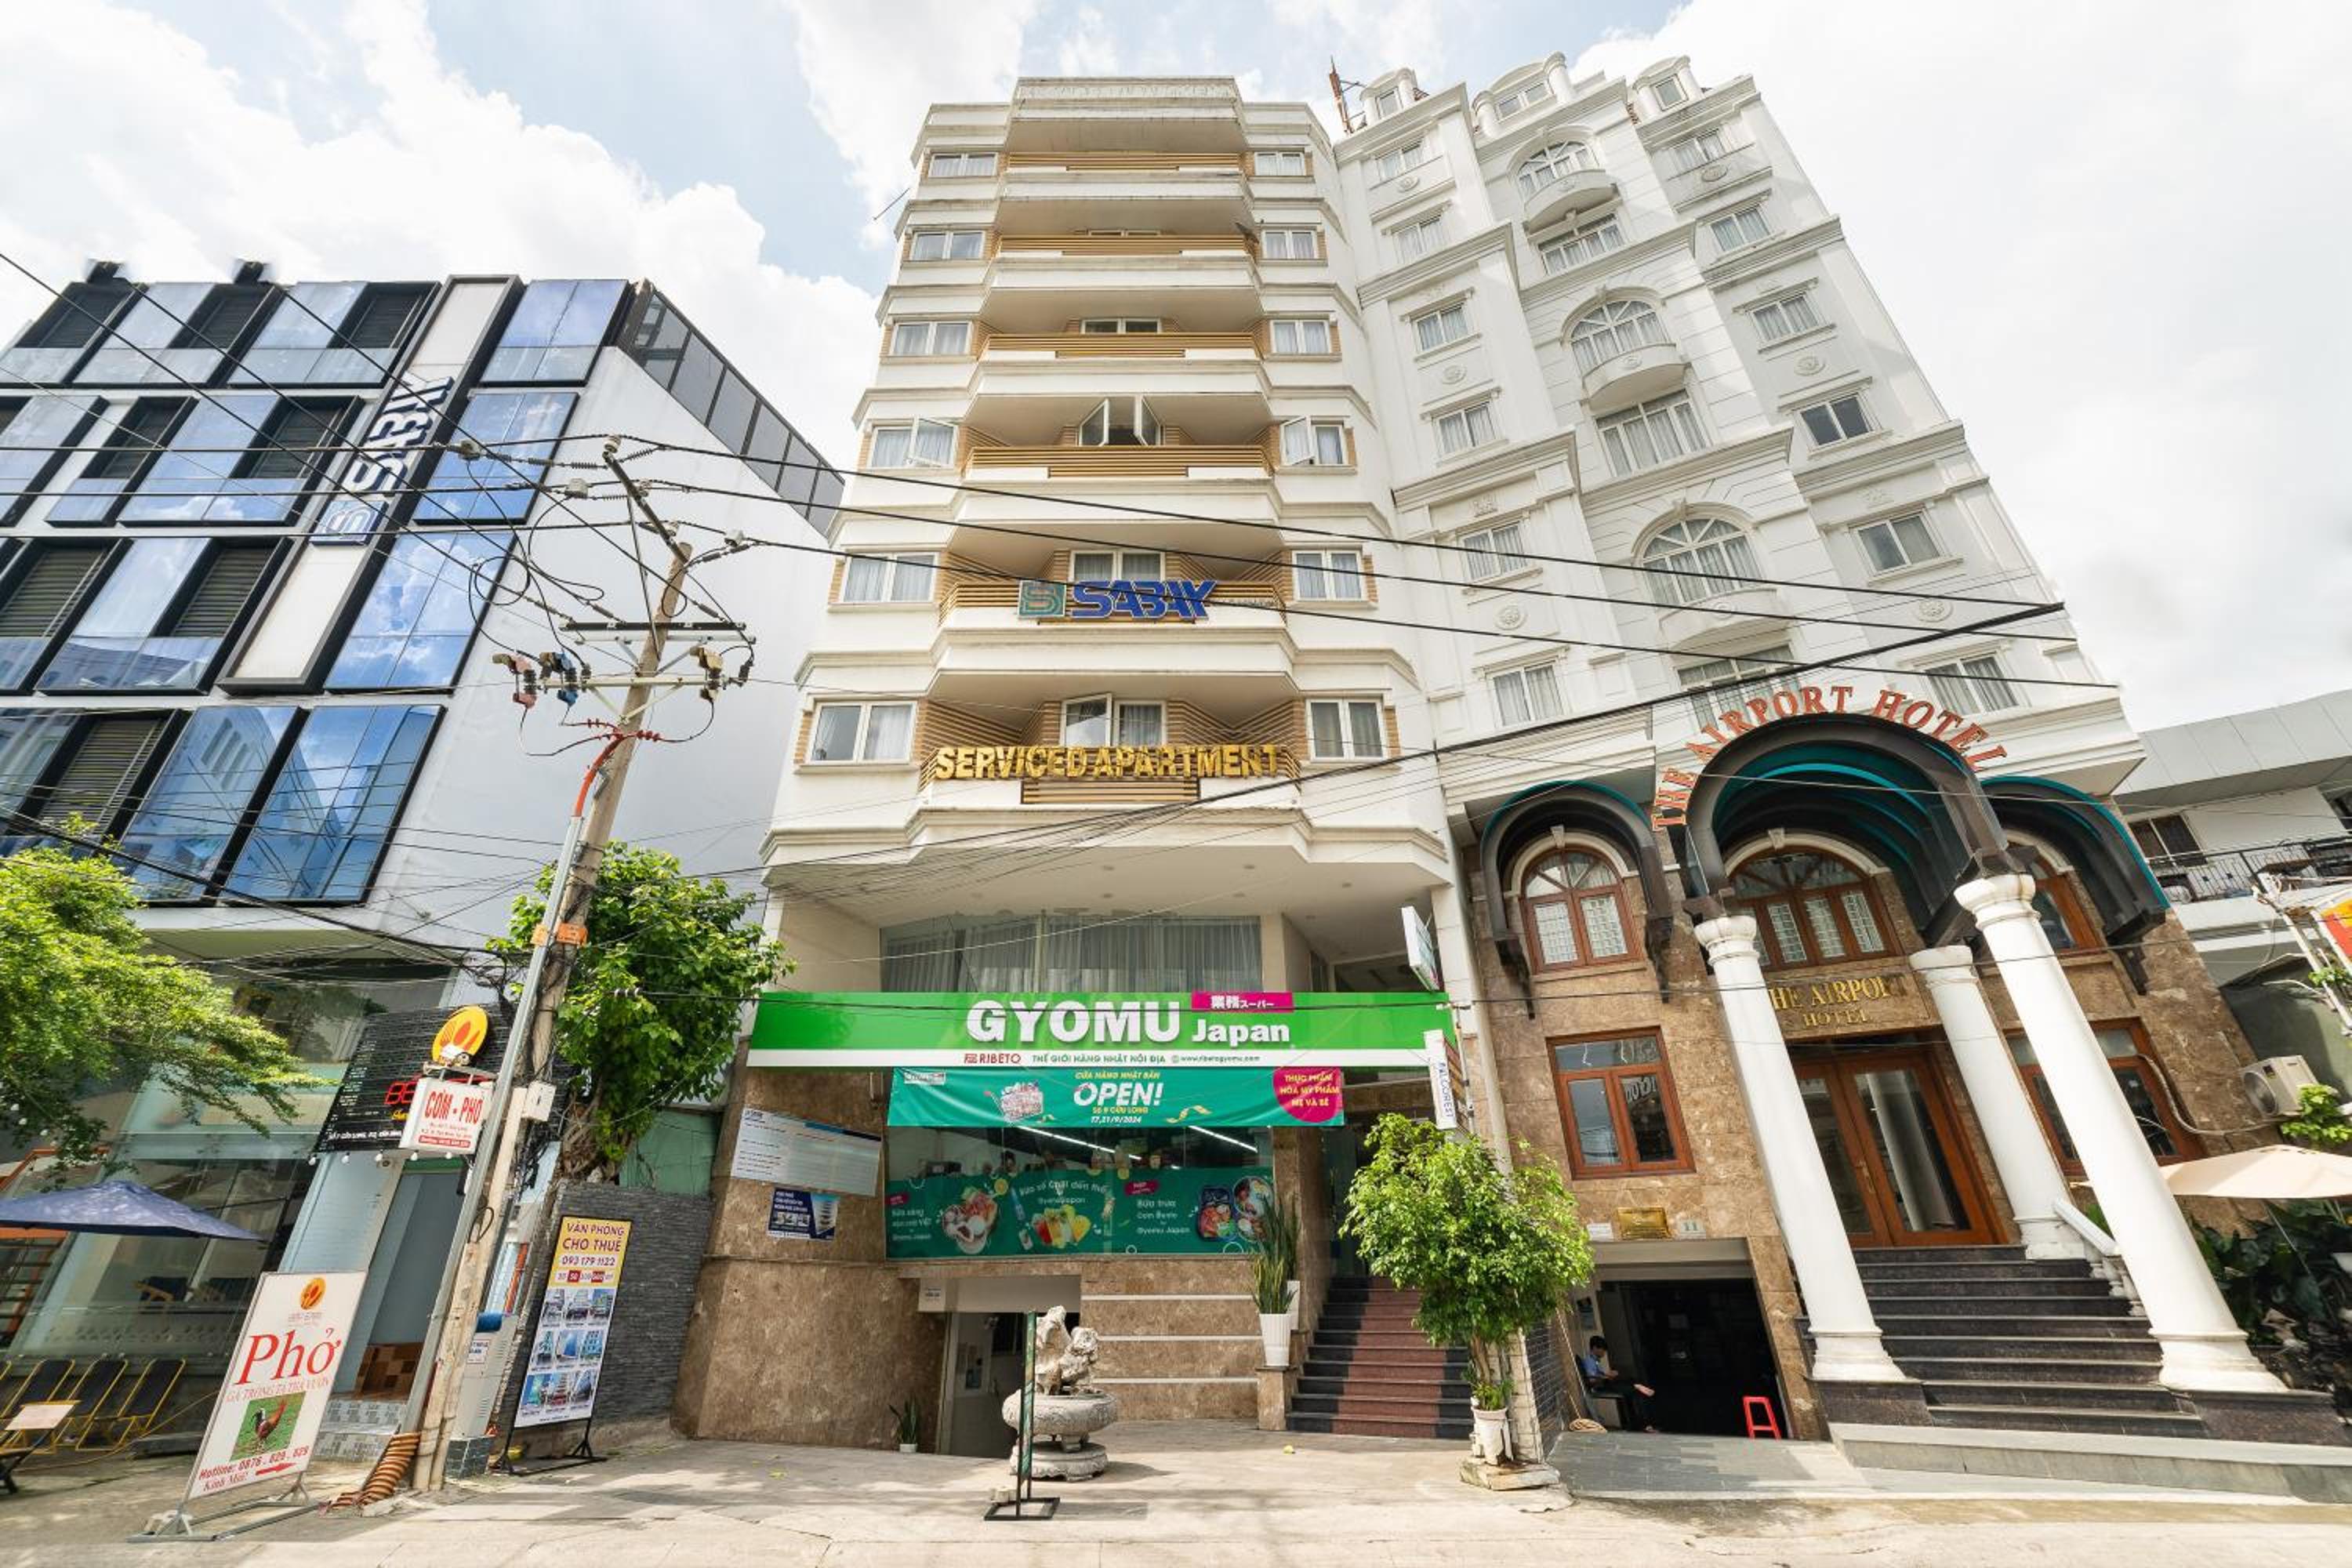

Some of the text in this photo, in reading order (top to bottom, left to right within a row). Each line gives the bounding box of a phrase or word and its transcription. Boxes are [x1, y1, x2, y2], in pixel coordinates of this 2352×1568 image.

[1684, 685, 1853, 764] AIRPORT
[1871, 688, 2008, 772] HOTEL
[935, 745, 1278, 779] SERVICED APARTMENT
[1768, 986, 1802, 1011] HE
[966, 1000, 1290, 1047] GYOMU Japan
[1803, 1009, 1868, 1027] HOTEL
[979, 1053, 1022, 1065] RIBETO
[1073, 1082, 1165, 1106] OPEN!
[562, 1237, 590, 1250] CHO
[234, 1327, 341, 1385] Phở
